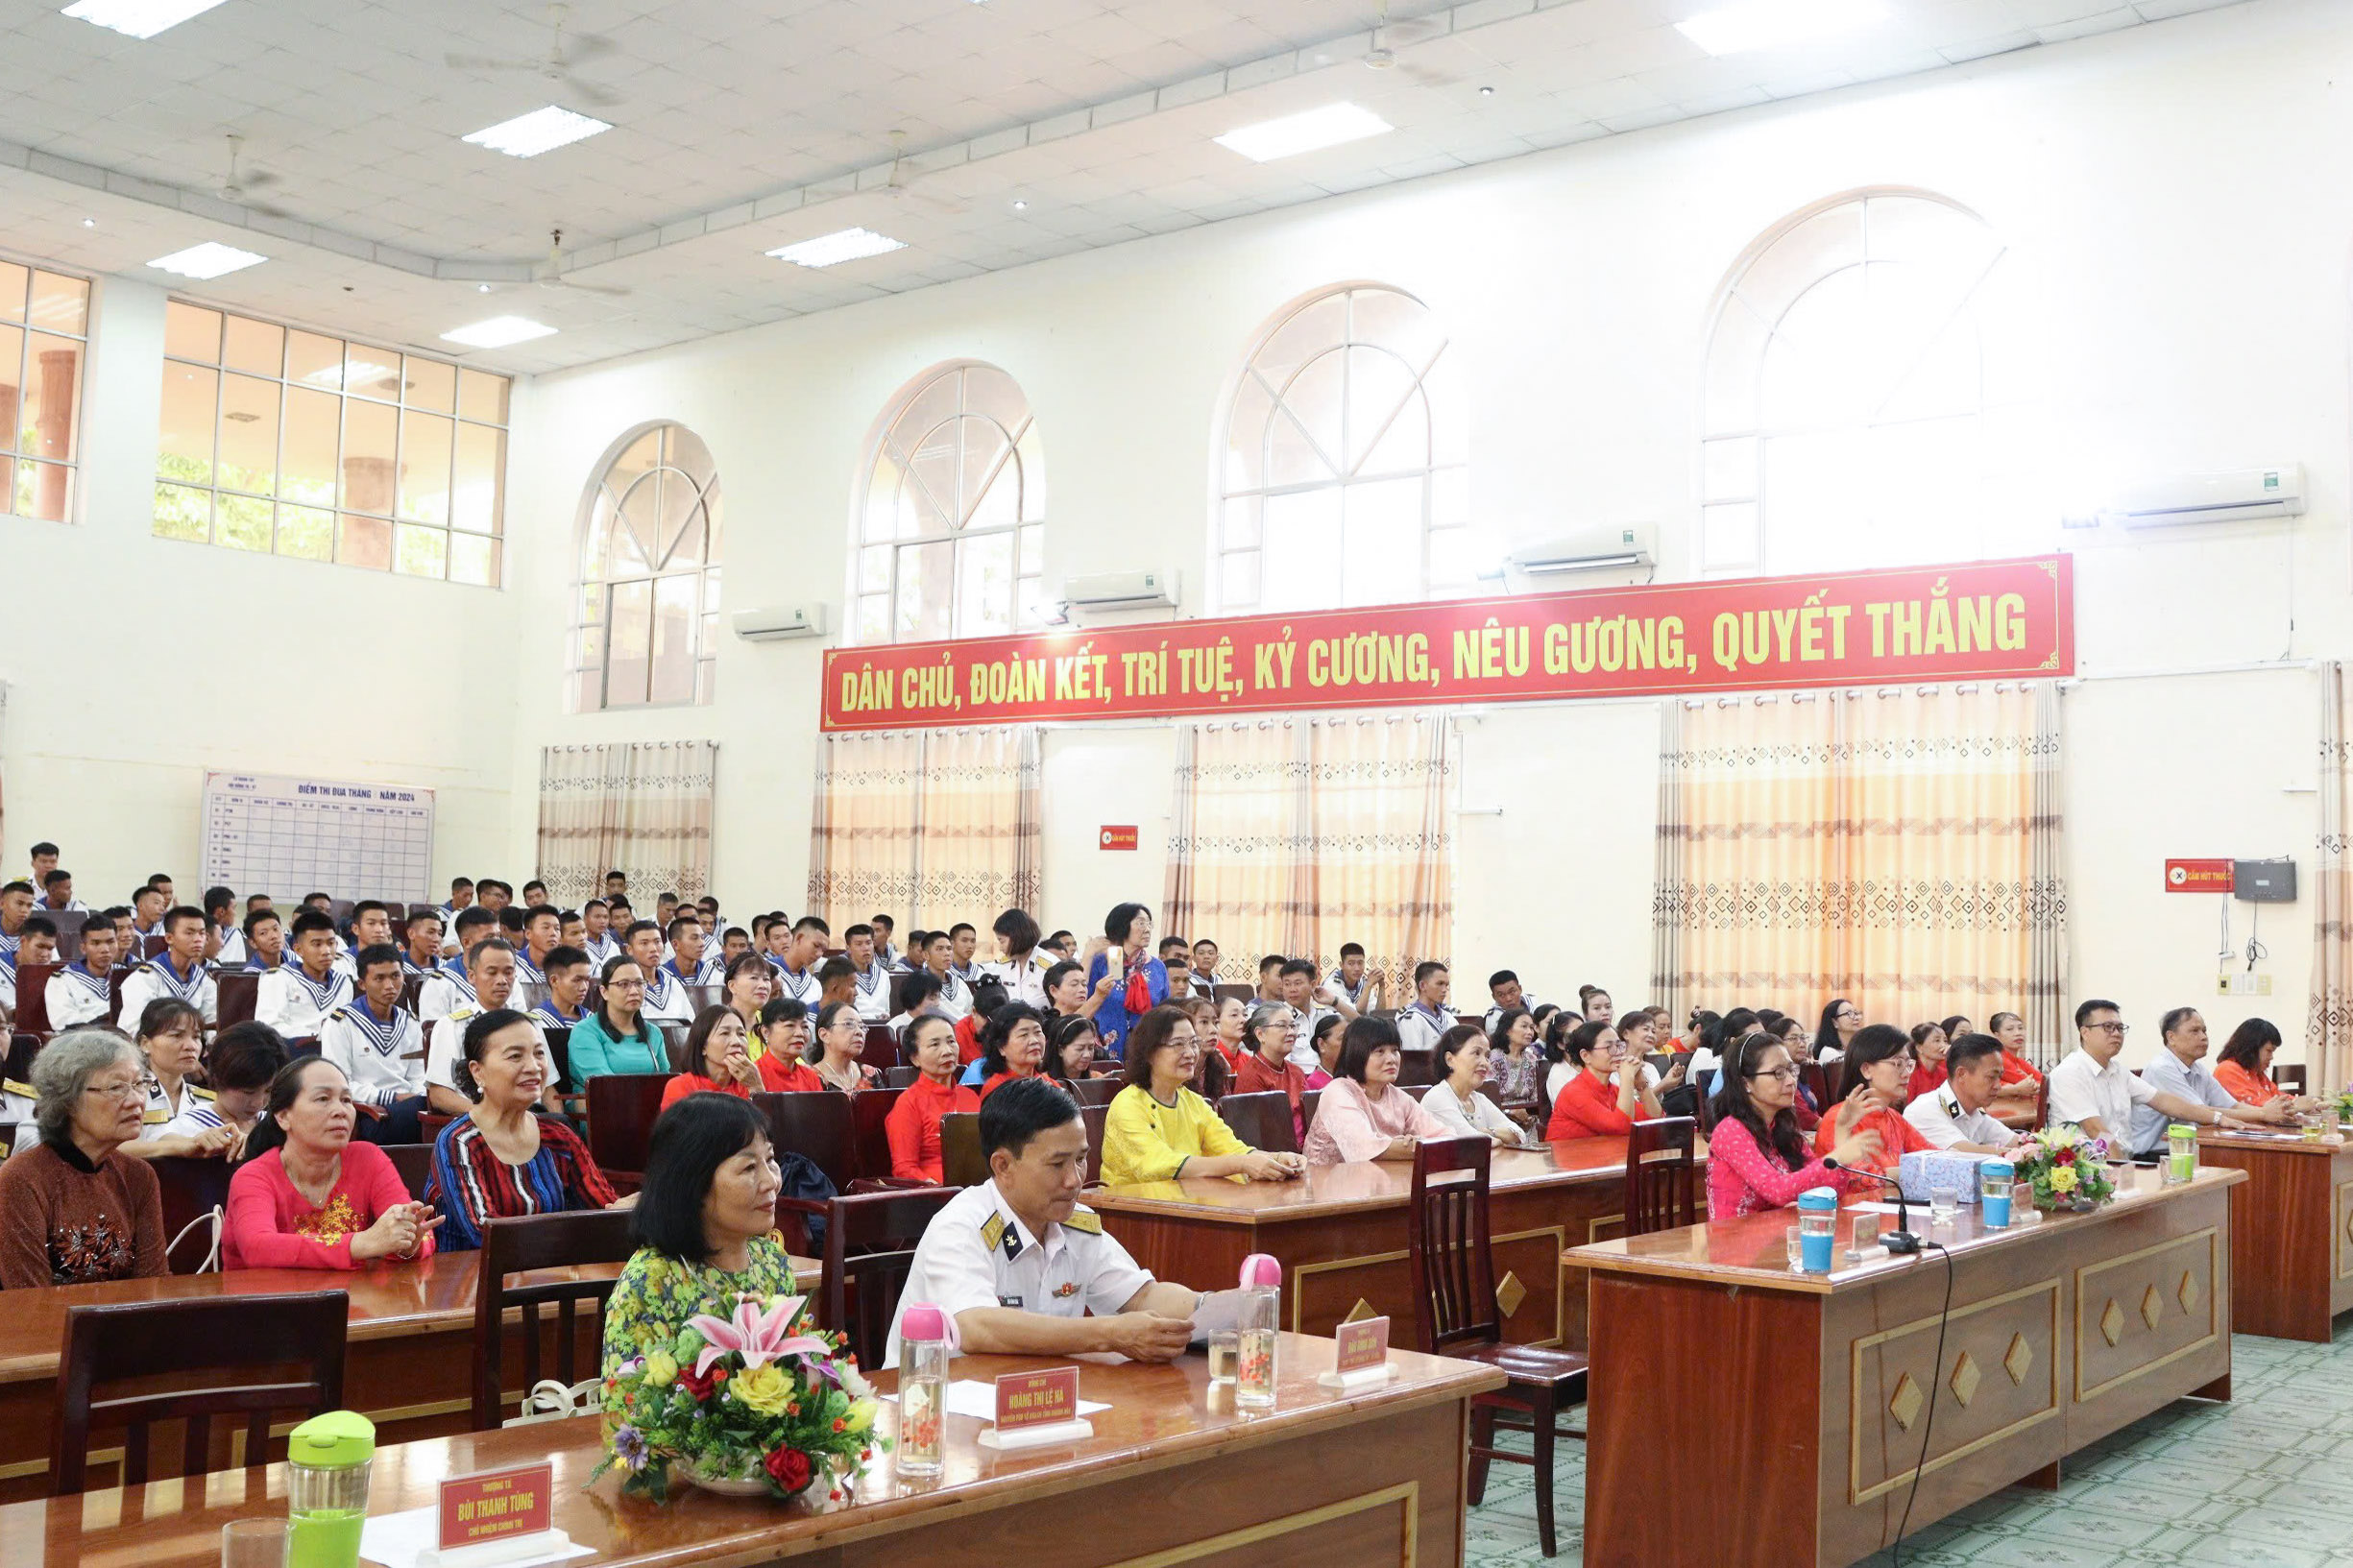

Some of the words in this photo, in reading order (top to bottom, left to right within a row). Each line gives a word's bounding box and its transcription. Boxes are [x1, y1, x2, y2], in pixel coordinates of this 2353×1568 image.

[841, 663, 893, 712] DÂN
[901, 652, 960, 712] CHỦ,
[970, 652, 1047, 706] ĐOÀN
[1055, 640, 1112, 704] KẾT,
[1122, 640, 1168, 697] TRÍ
[1177, 636, 1244, 702] TUỆ,
[1255, 625, 1297, 689] KỶ
[1308, 631, 1440, 688] CƯƠNG,
[1453, 617, 1529, 680] NÊU
[1543, 614, 1697, 675] GƯƠNG,
[1712, 589, 1851, 671] QUYẾT
[1865, 576, 2026, 658] THẮNG
[319, 786, 330, 796] THI
[398, 792, 415, 803] 2024
[458, 1498, 474, 1521] BÙI
[477, 1496, 508, 1518] THANH
[510, 1490, 534, 1512] TÙNG
